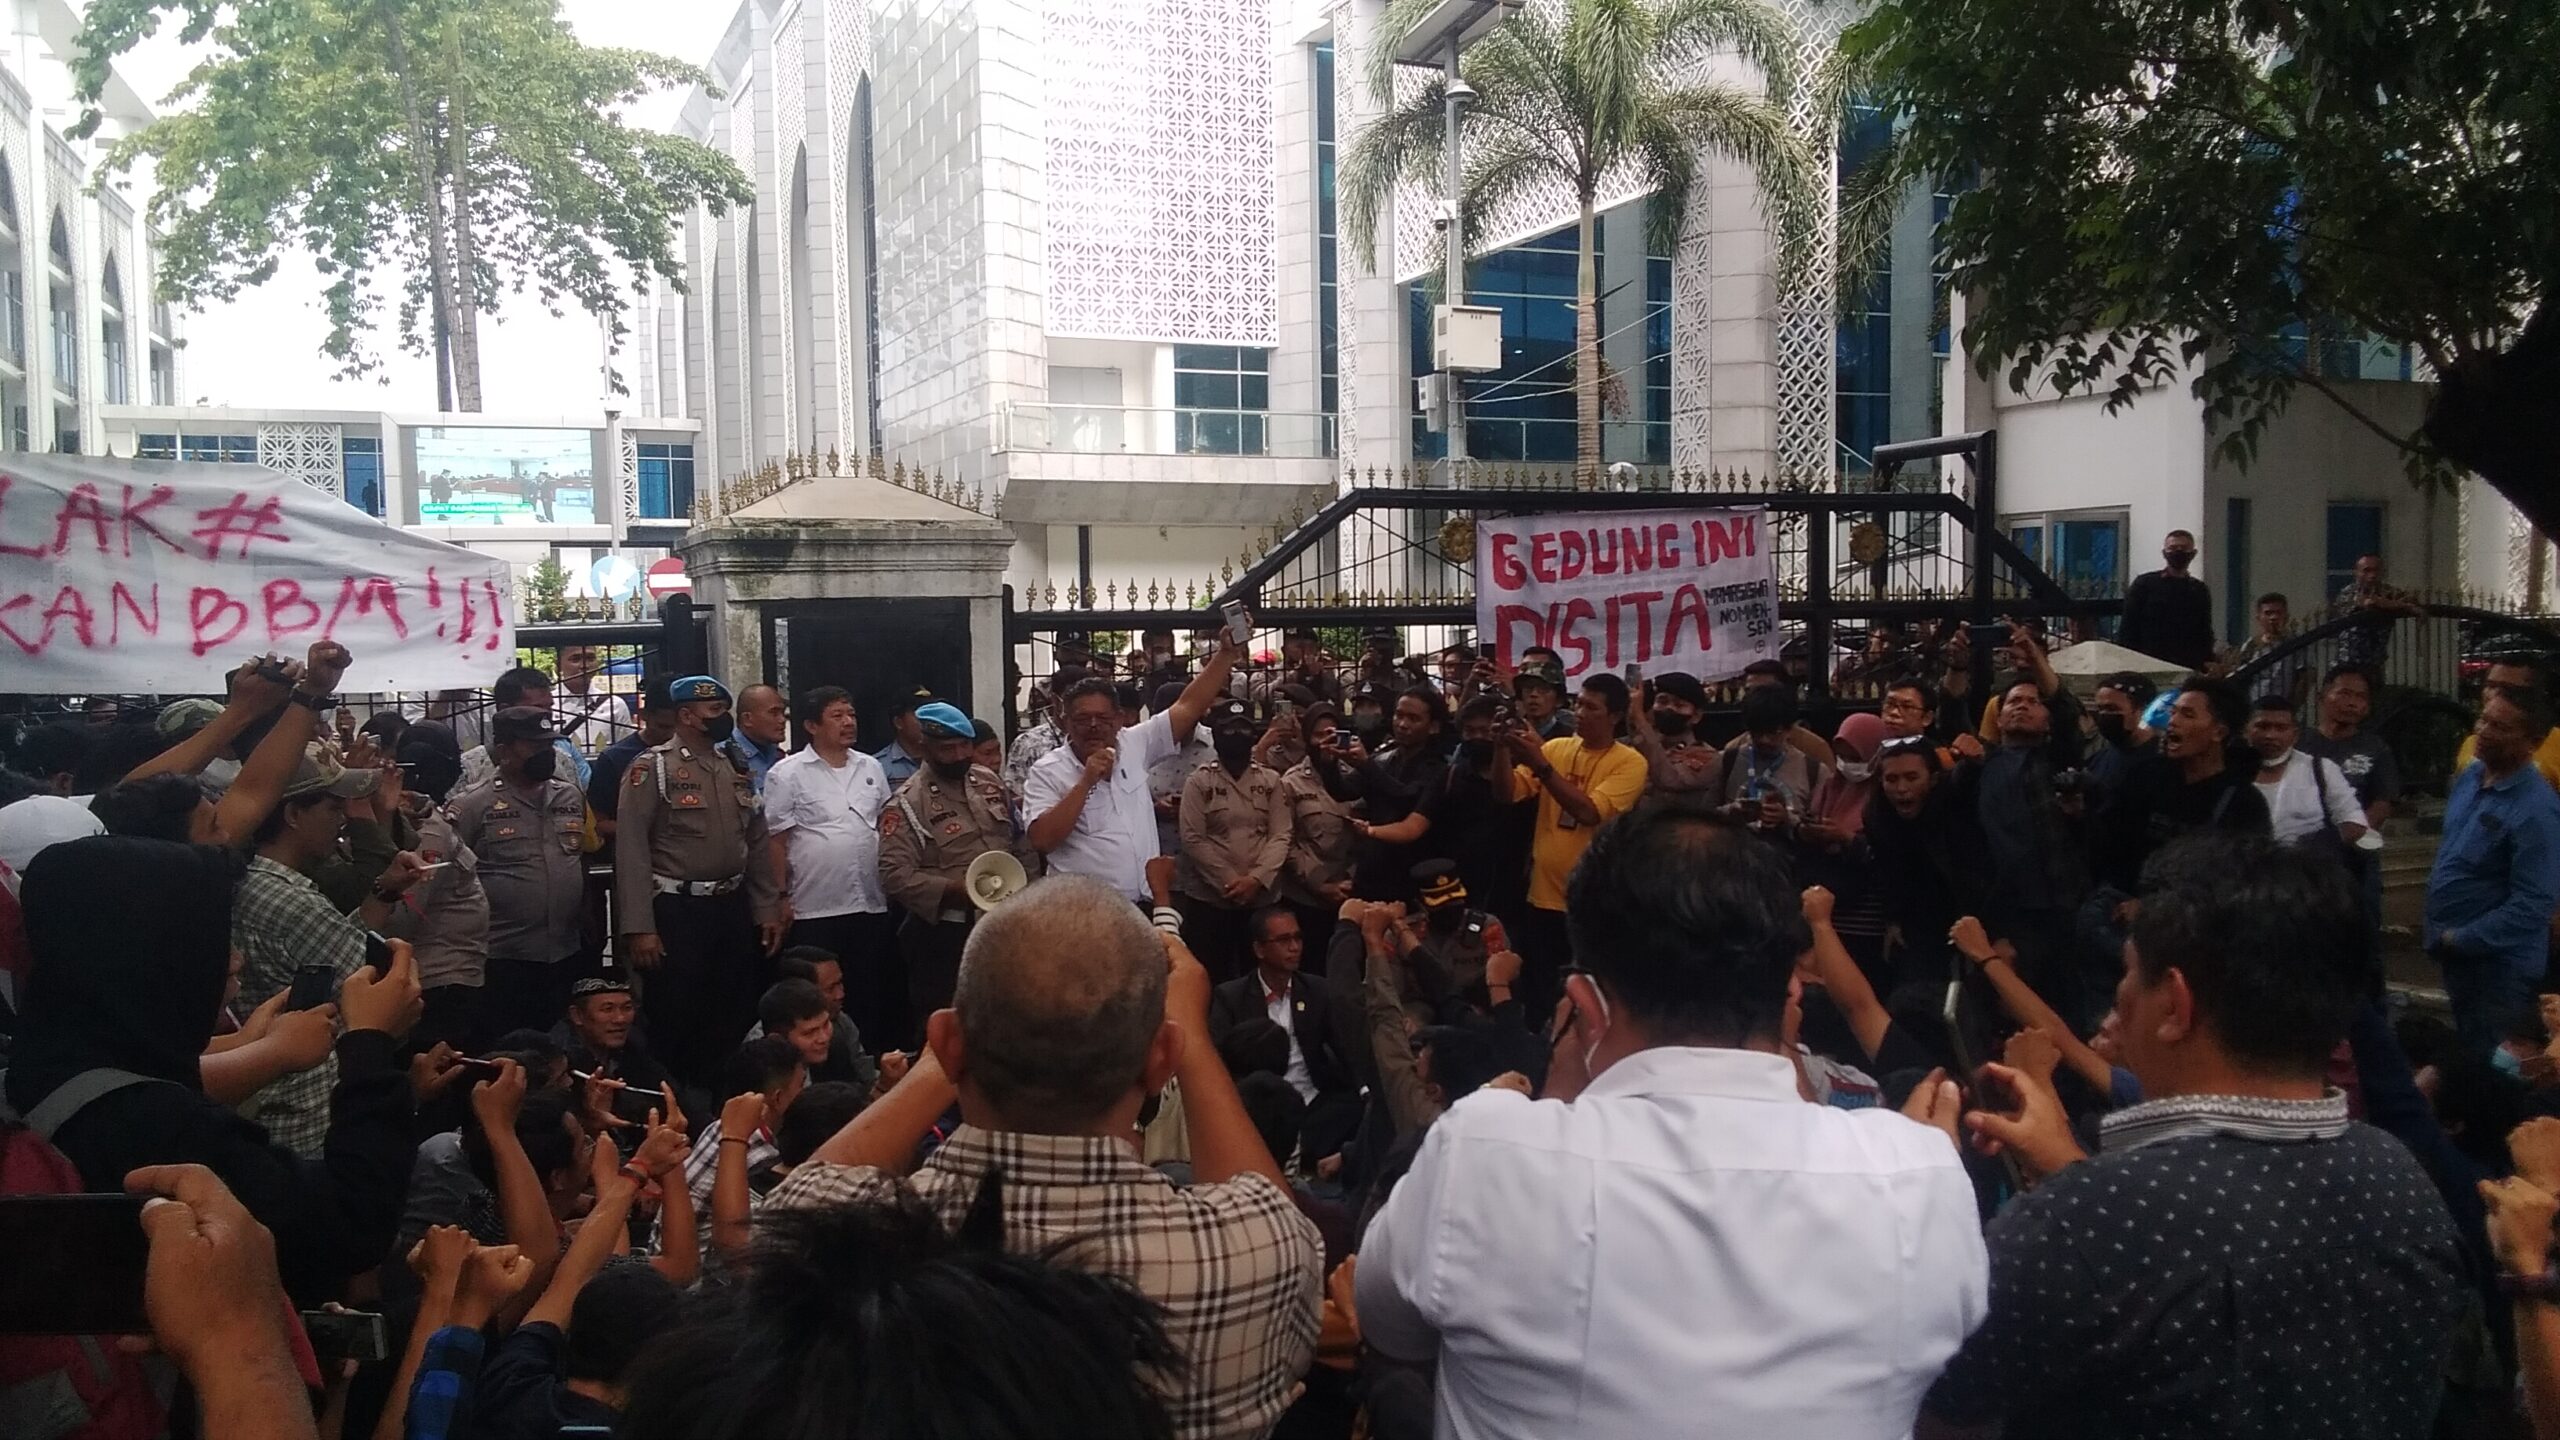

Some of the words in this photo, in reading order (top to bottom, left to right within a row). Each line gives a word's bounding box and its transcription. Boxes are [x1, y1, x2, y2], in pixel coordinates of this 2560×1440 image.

[1492, 523, 1680, 591] GEDUNG
[1691, 515, 1756, 567] INI
[1494, 583, 1711, 677] DISITA
[1747, 618, 1772, 637] SEN
